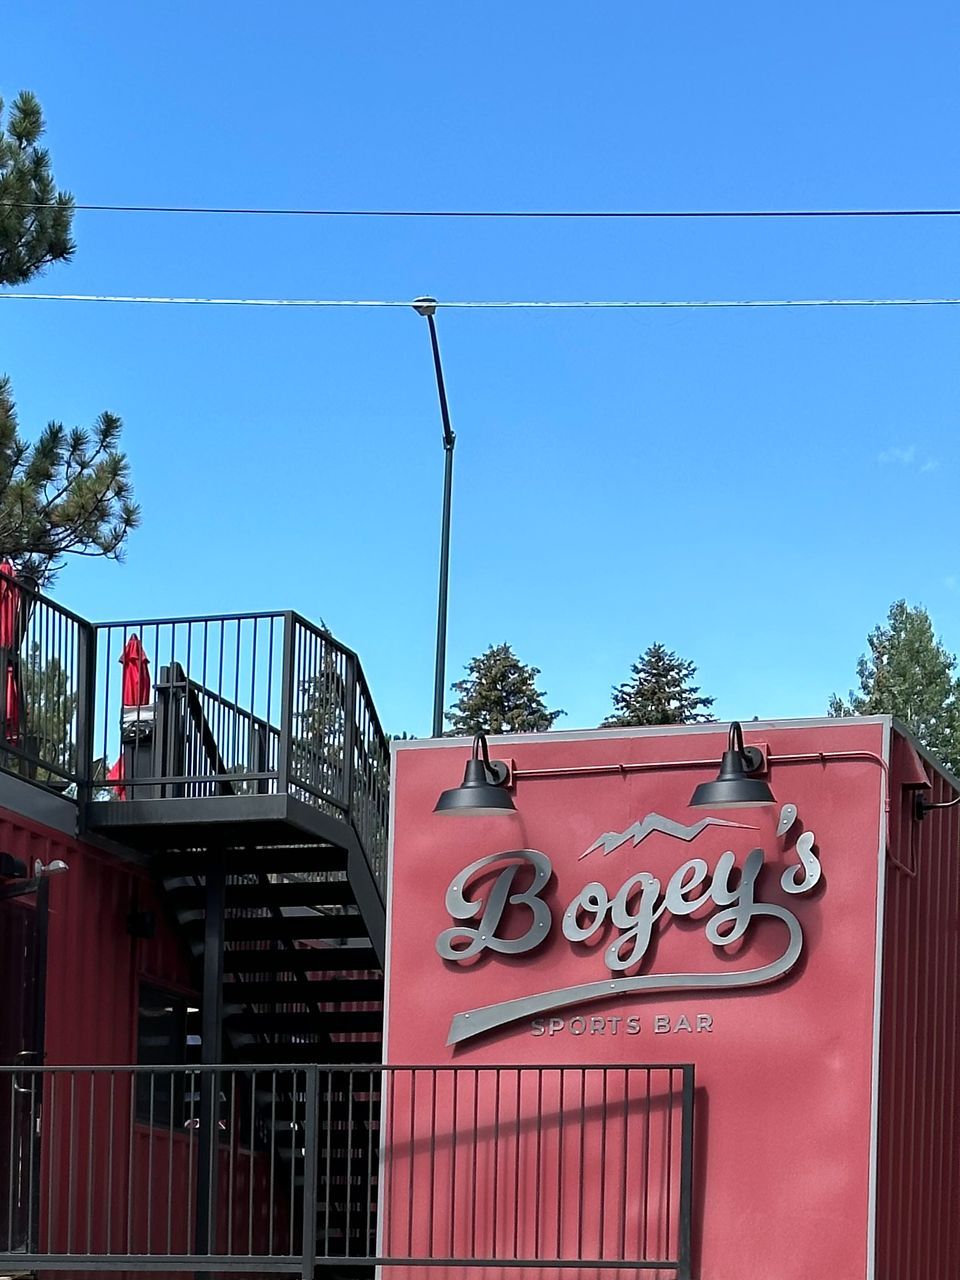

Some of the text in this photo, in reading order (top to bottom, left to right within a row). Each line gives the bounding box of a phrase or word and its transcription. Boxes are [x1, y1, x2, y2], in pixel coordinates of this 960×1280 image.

[435, 803, 822, 973] Bogey's
[530, 1013, 714, 1036] SPORTS BAR
